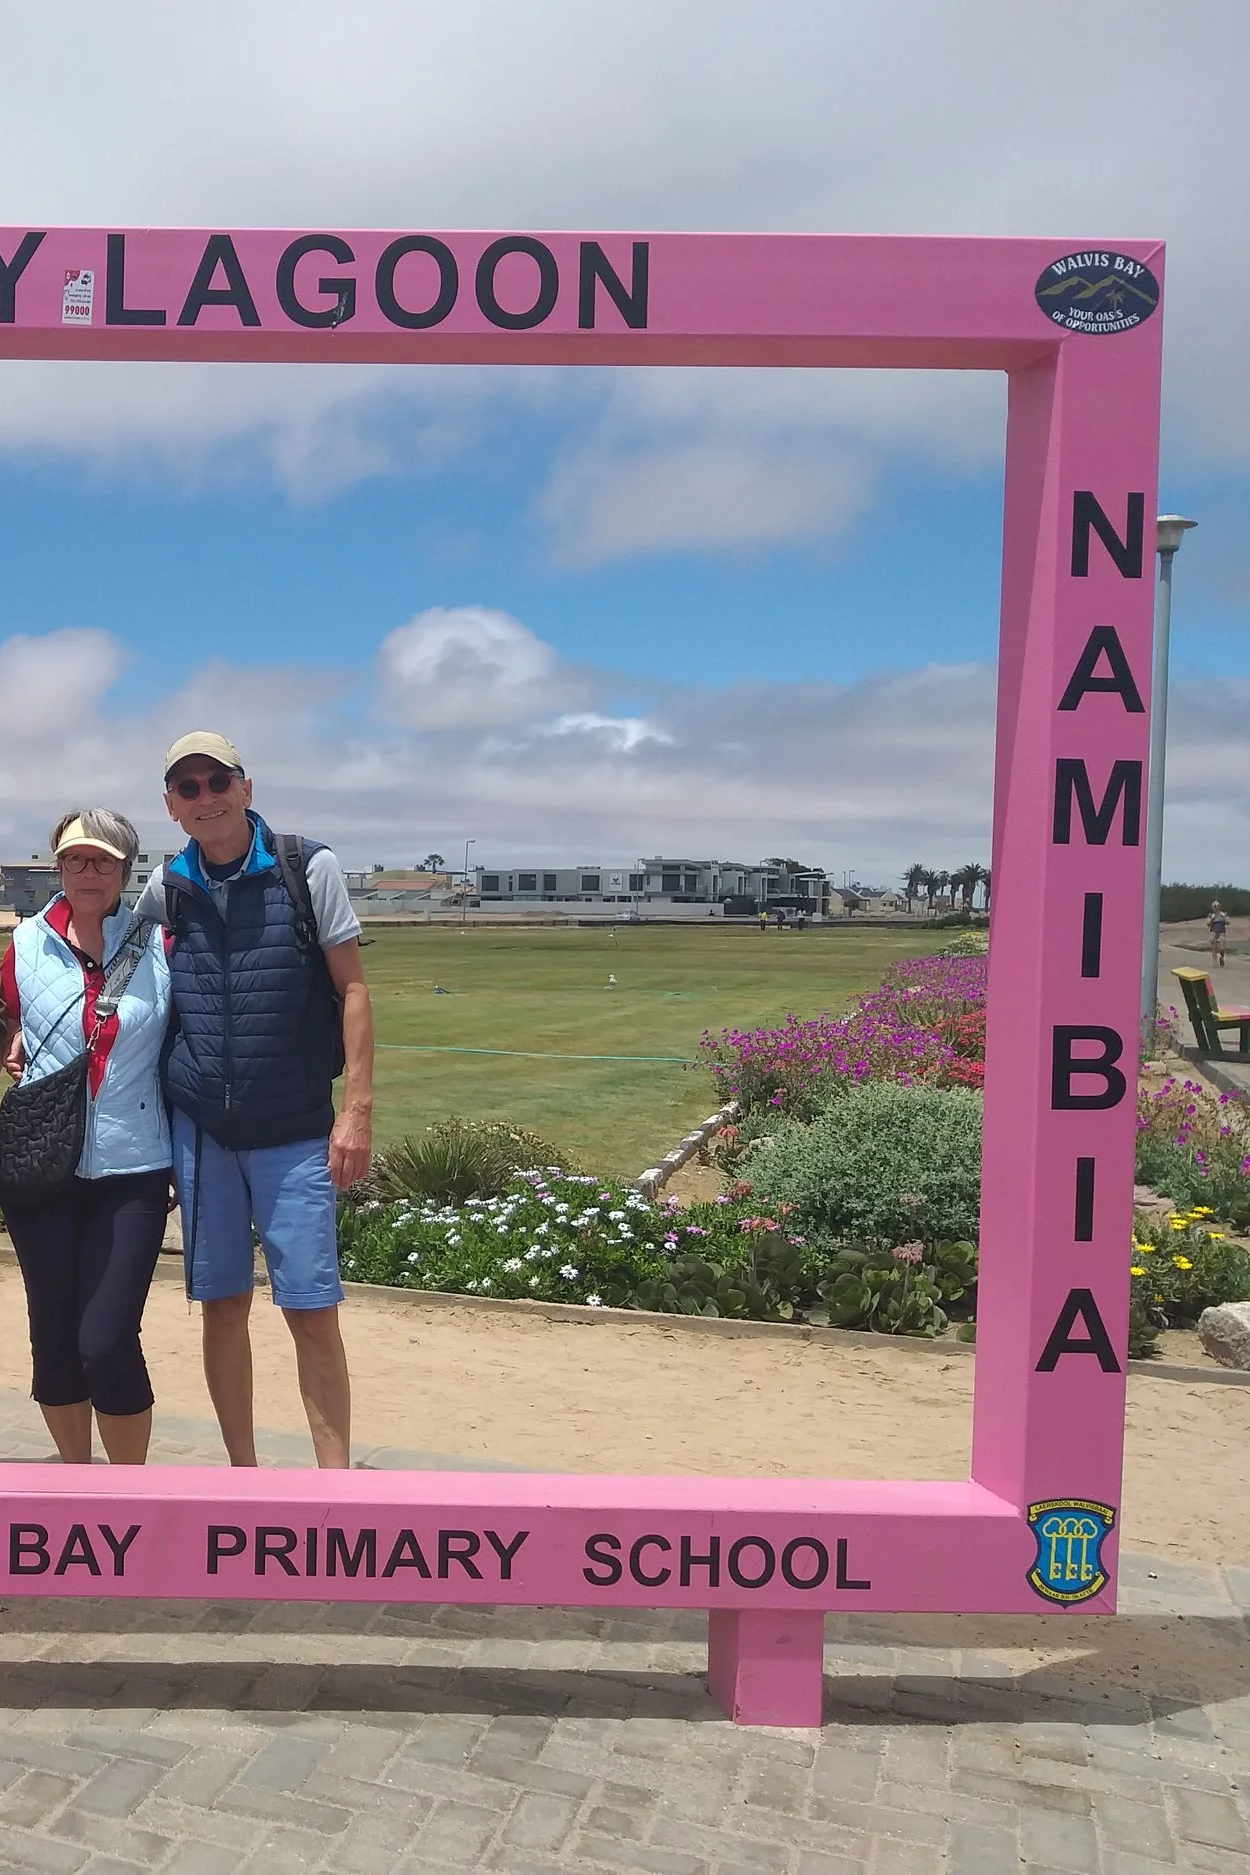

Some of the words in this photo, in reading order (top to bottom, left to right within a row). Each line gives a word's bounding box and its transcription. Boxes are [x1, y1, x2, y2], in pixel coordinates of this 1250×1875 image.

[1051, 253, 1110, 275] WALVIS
[1114, 257, 1145, 278] BAY
[105, 233, 650, 331] LAGOON
[65, 304, 90, 316] 99000
[1052, 310, 1066, 322] OF
[1065, 313, 1140, 332] OPPORTUNITIES
[1069, 306, 1094, 321] YOUR
[1034, 490, 1146, 1374] NAMIBIA
[9, 1523, 142, 1577] BAY
[206, 1525, 531, 1580] PRIMARY
[582, 1533, 871, 1590] SCHOOL
